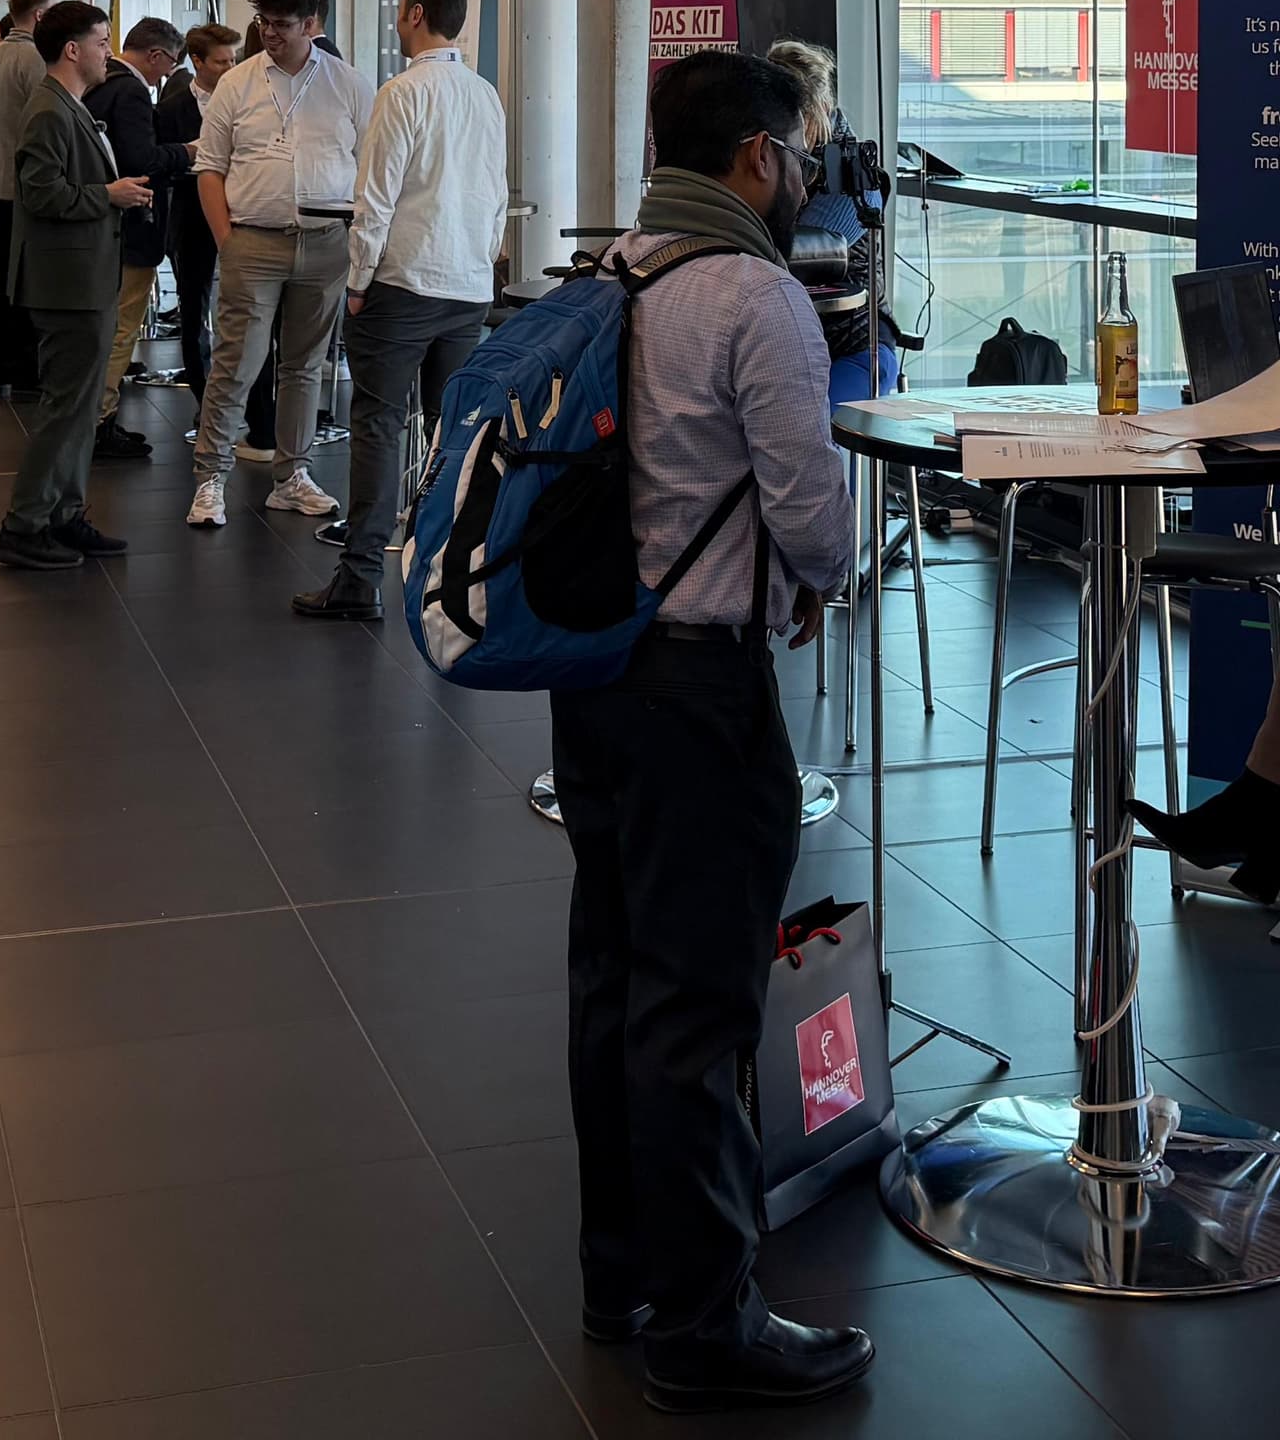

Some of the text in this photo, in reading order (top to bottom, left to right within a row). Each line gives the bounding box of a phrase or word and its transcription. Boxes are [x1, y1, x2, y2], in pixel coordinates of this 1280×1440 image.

[652, 9, 721, 35] DAS KIT
[1245, 16, 1267, 33] It's
[1251, 41, 1270, 55] us
[1243, 241, 1279, 258] With
[1232, 523, 1263, 542] We
[804, 1056, 858, 1100] HANNOVER
[815, 1075, 851, 1105] MESSE
